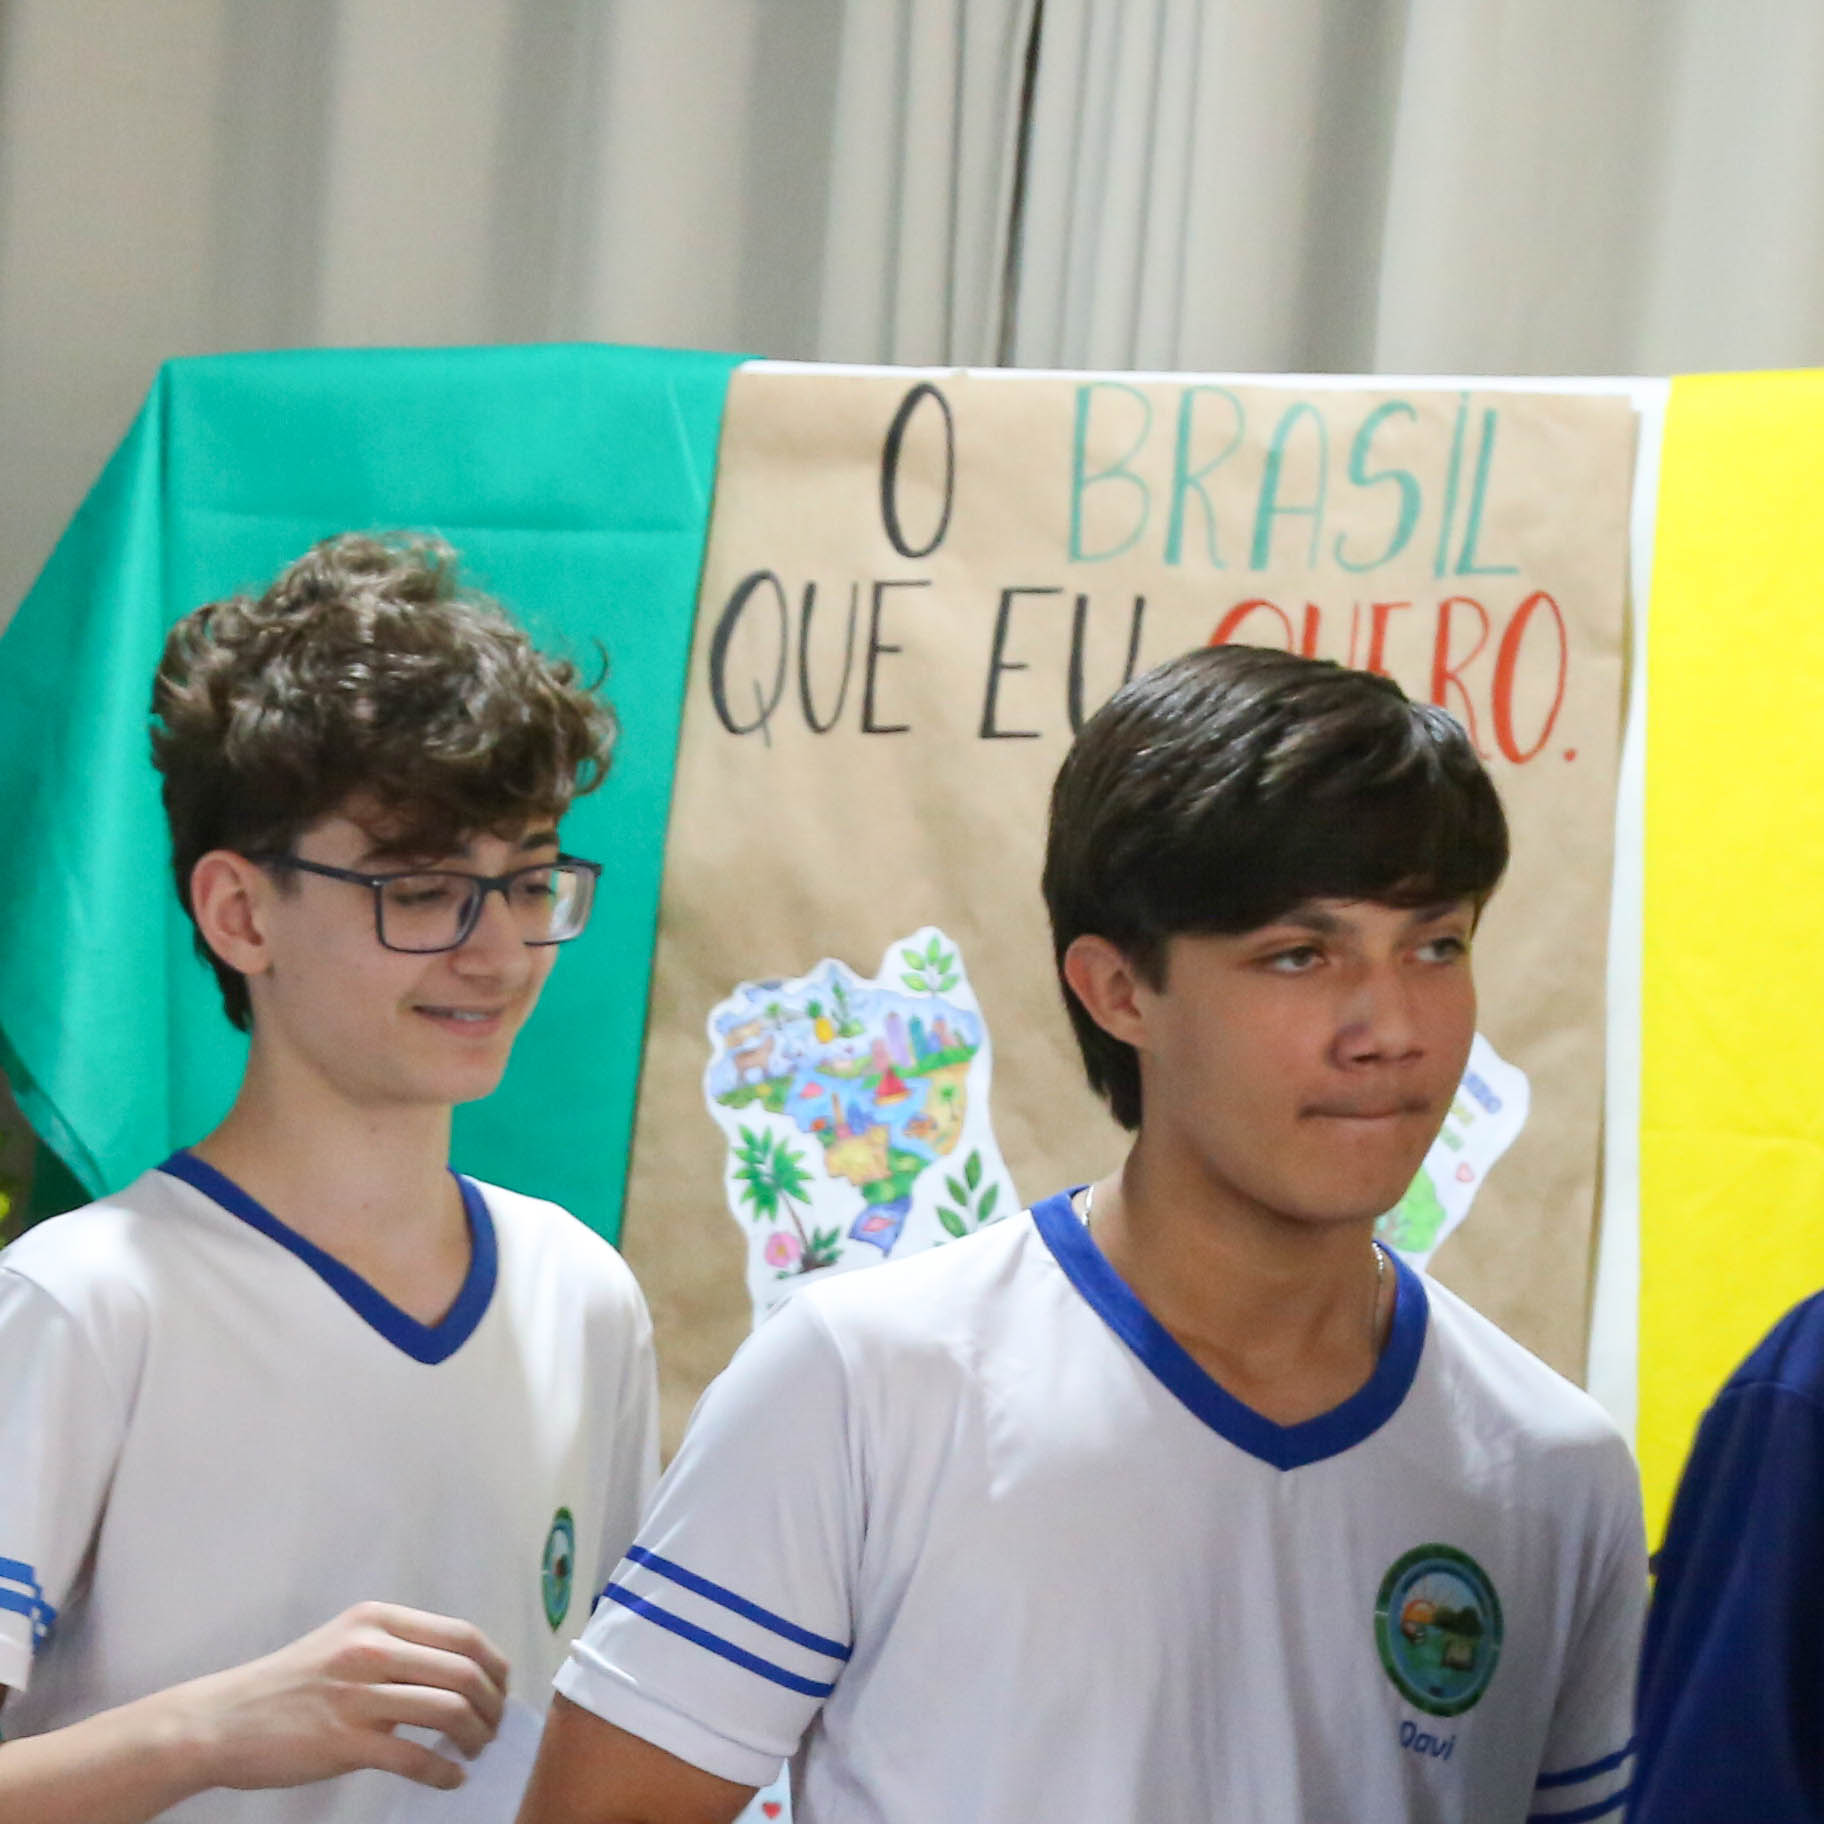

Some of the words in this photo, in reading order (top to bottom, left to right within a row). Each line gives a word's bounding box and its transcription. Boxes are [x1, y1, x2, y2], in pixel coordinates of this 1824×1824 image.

[877, 380, 956, 559] O
[1066, 380, 1520, 579] BRASIL
[708, 569, 933, 748] QUE
[976, 588, 1146, 740] EU
